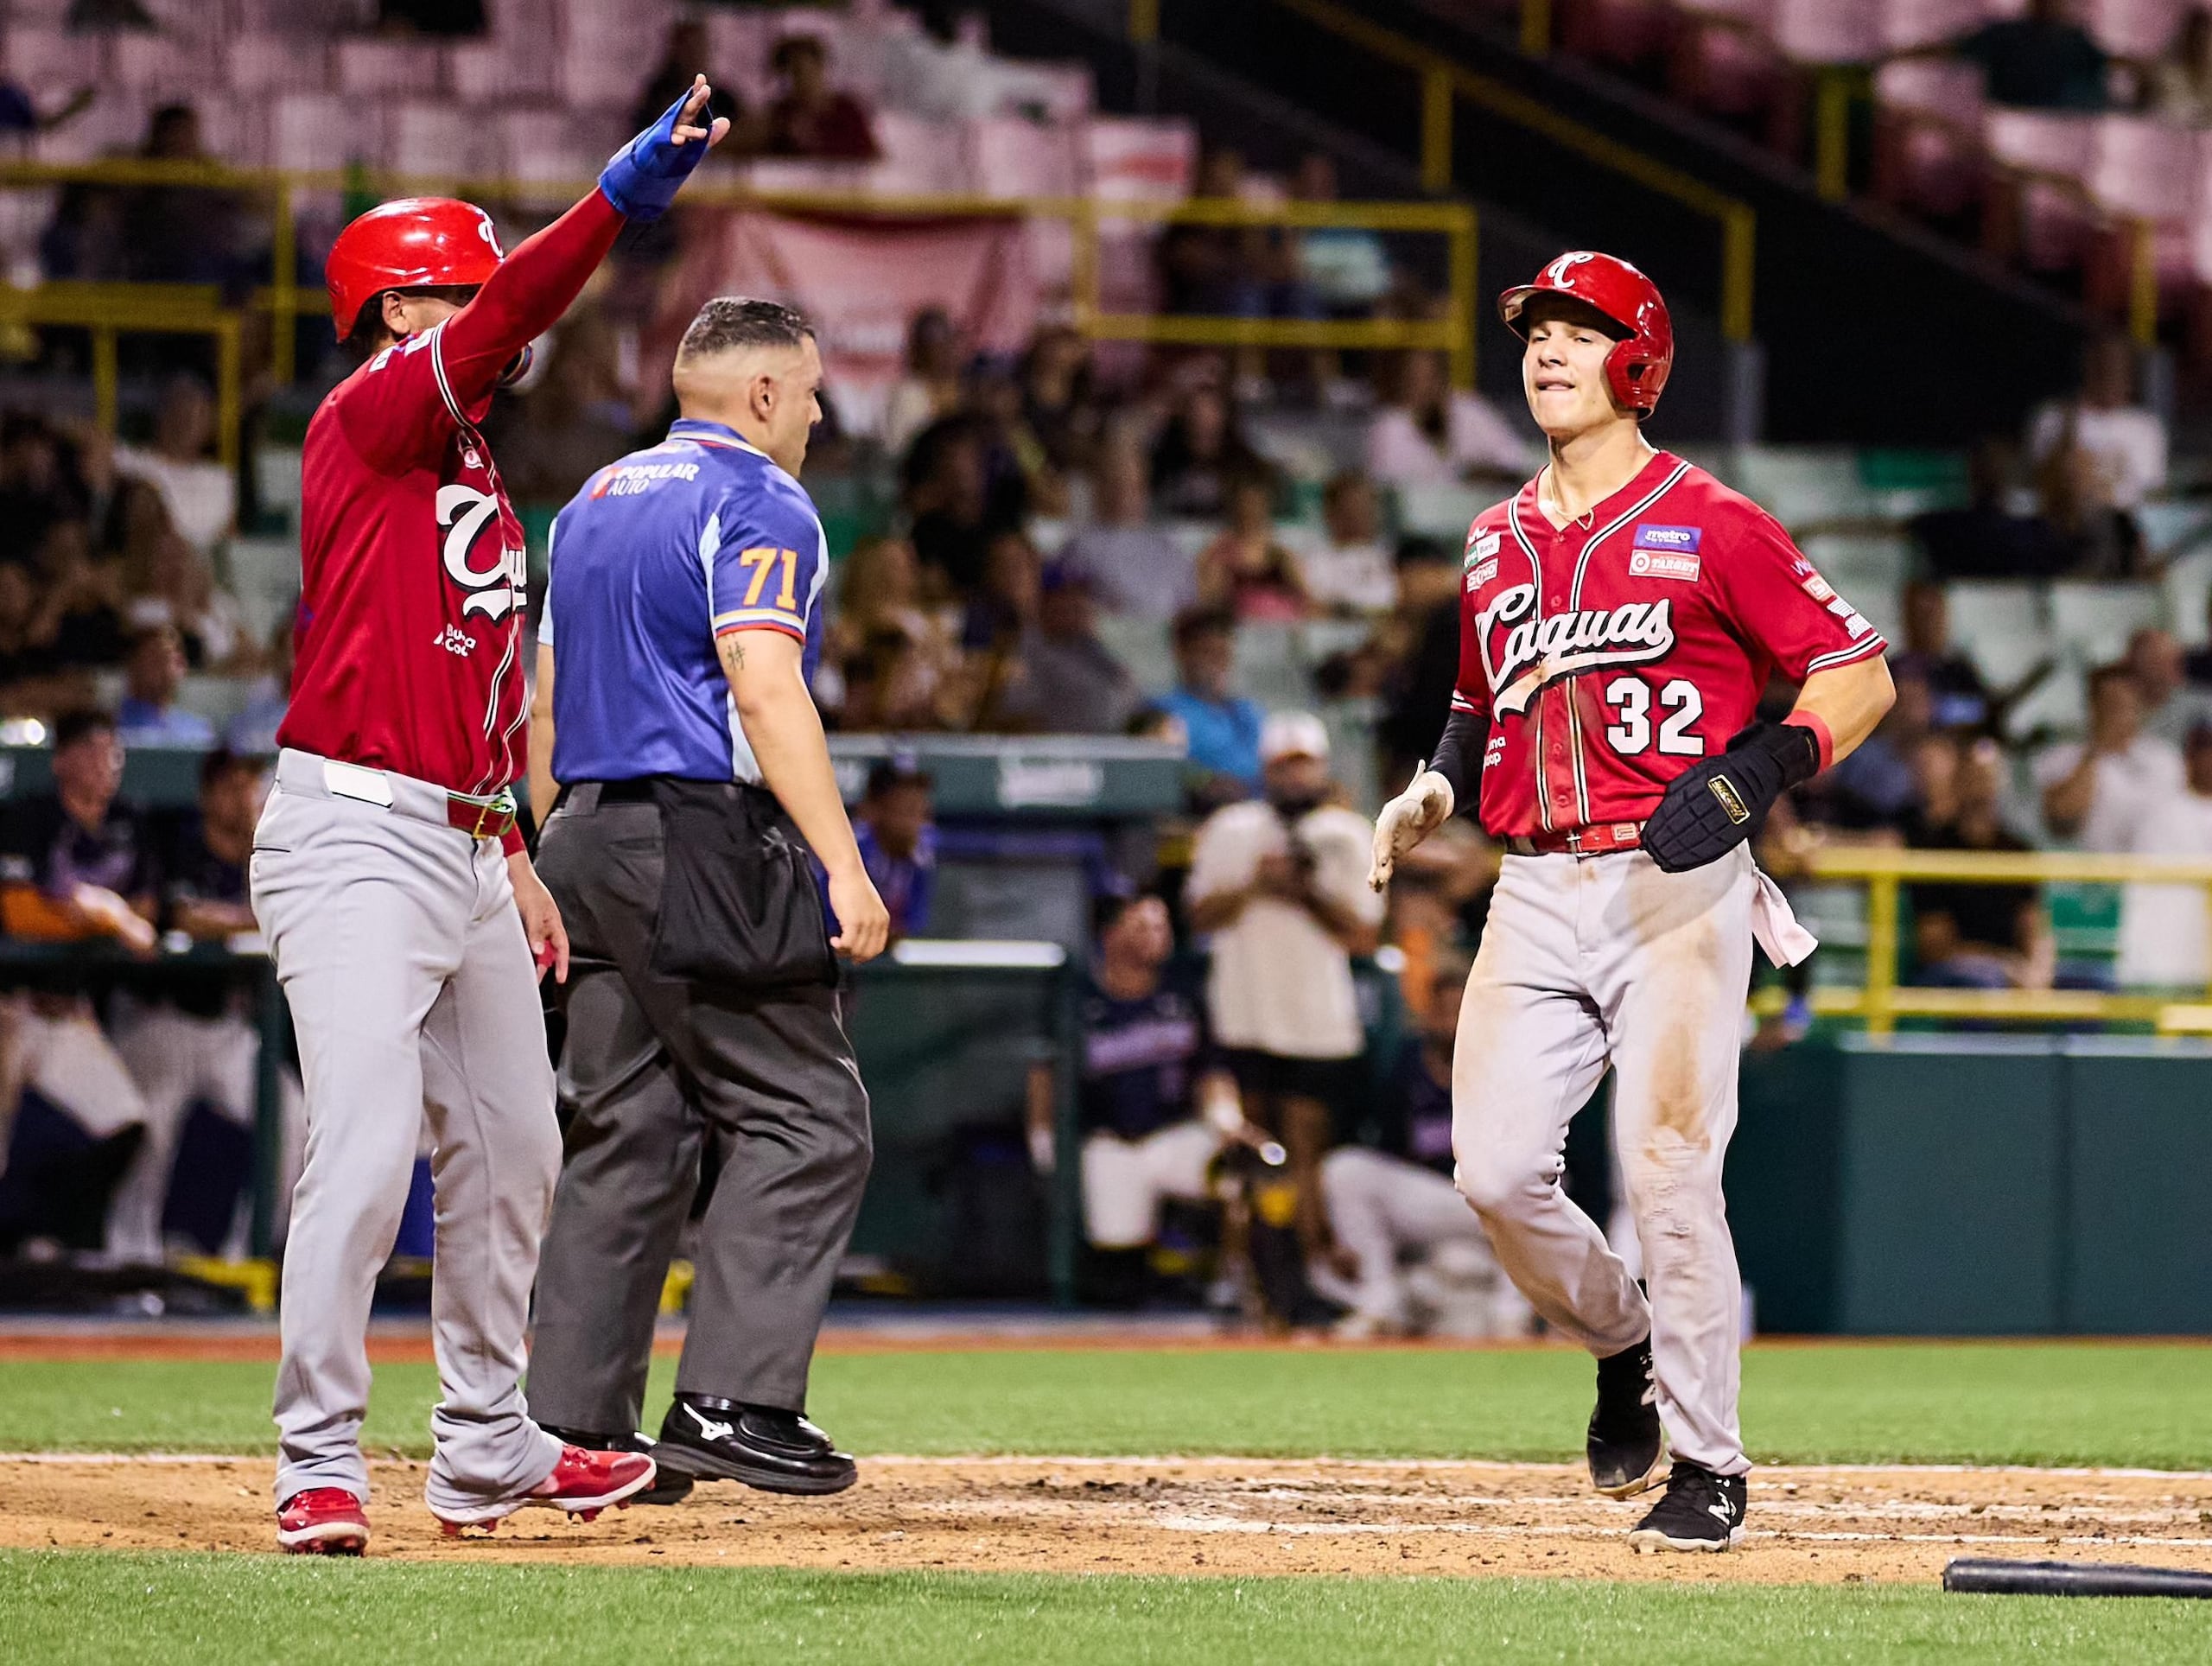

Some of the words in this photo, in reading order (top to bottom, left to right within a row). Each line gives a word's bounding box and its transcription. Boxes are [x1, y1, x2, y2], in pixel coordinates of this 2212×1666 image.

[607, 477, 650, 496] AUTO
[614, 462, 700, 482] POPULAR
[1645, 530, 1691, 541] metro
[740, 548, 798, 611] 71
[1475, 582, 1675, 723] Caguas
[1605, 676, 1706, 755] 32
